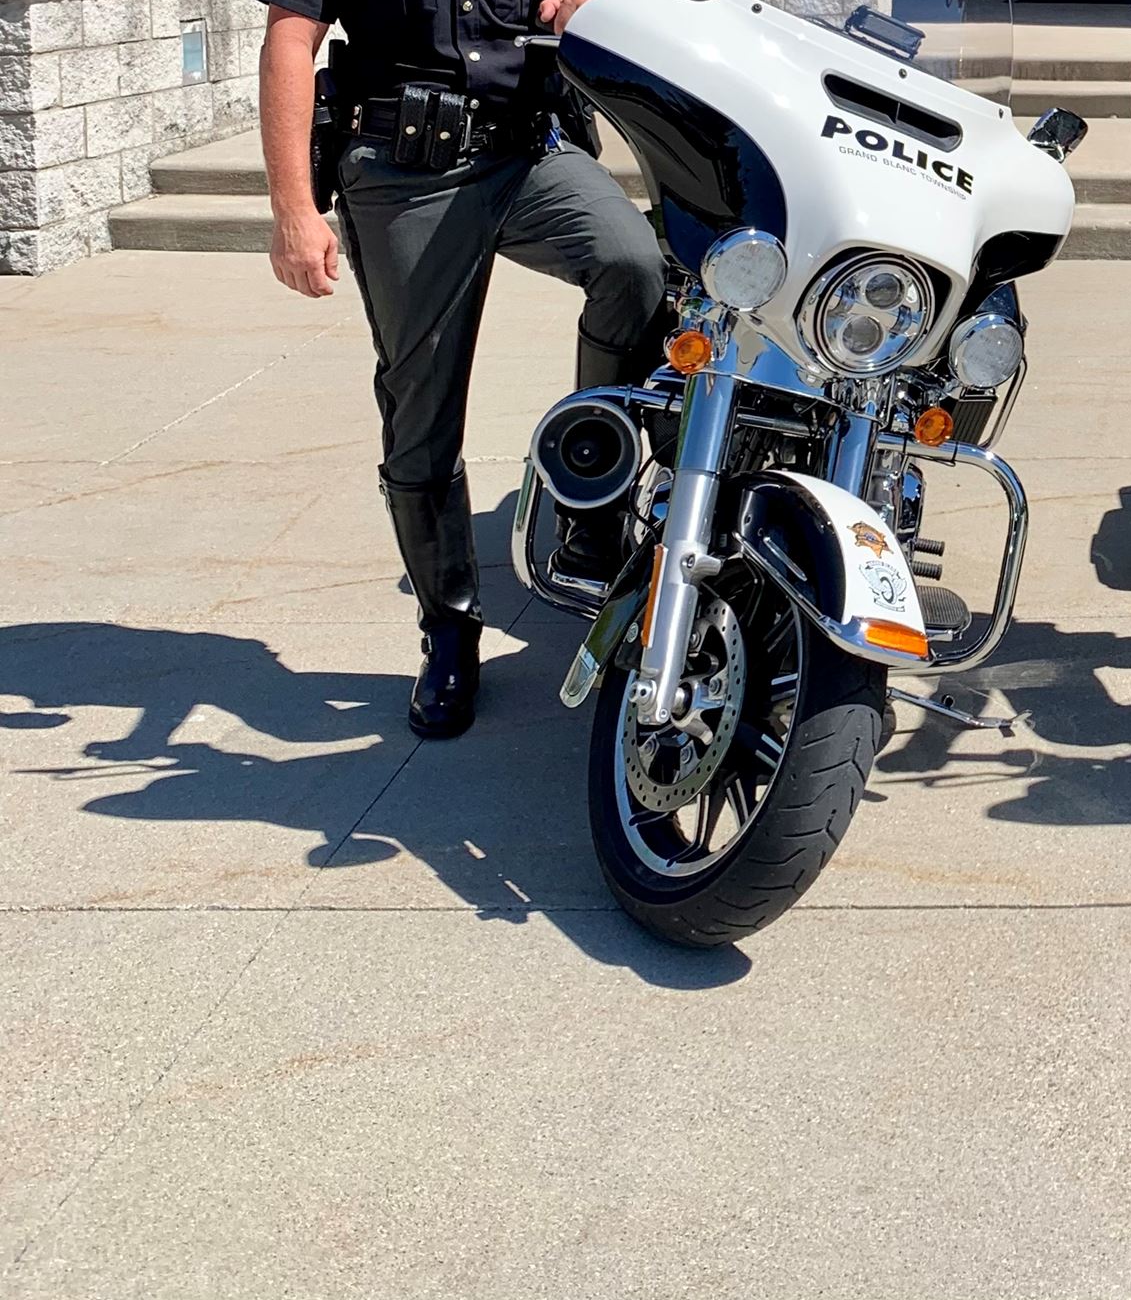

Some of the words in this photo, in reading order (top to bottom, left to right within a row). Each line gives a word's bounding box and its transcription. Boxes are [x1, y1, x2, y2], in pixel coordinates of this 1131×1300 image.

[821, 115, 974, 195] POLICE
[838, 146, 878, 162] GRAND
[883, 158, 917, 176] BLANC
